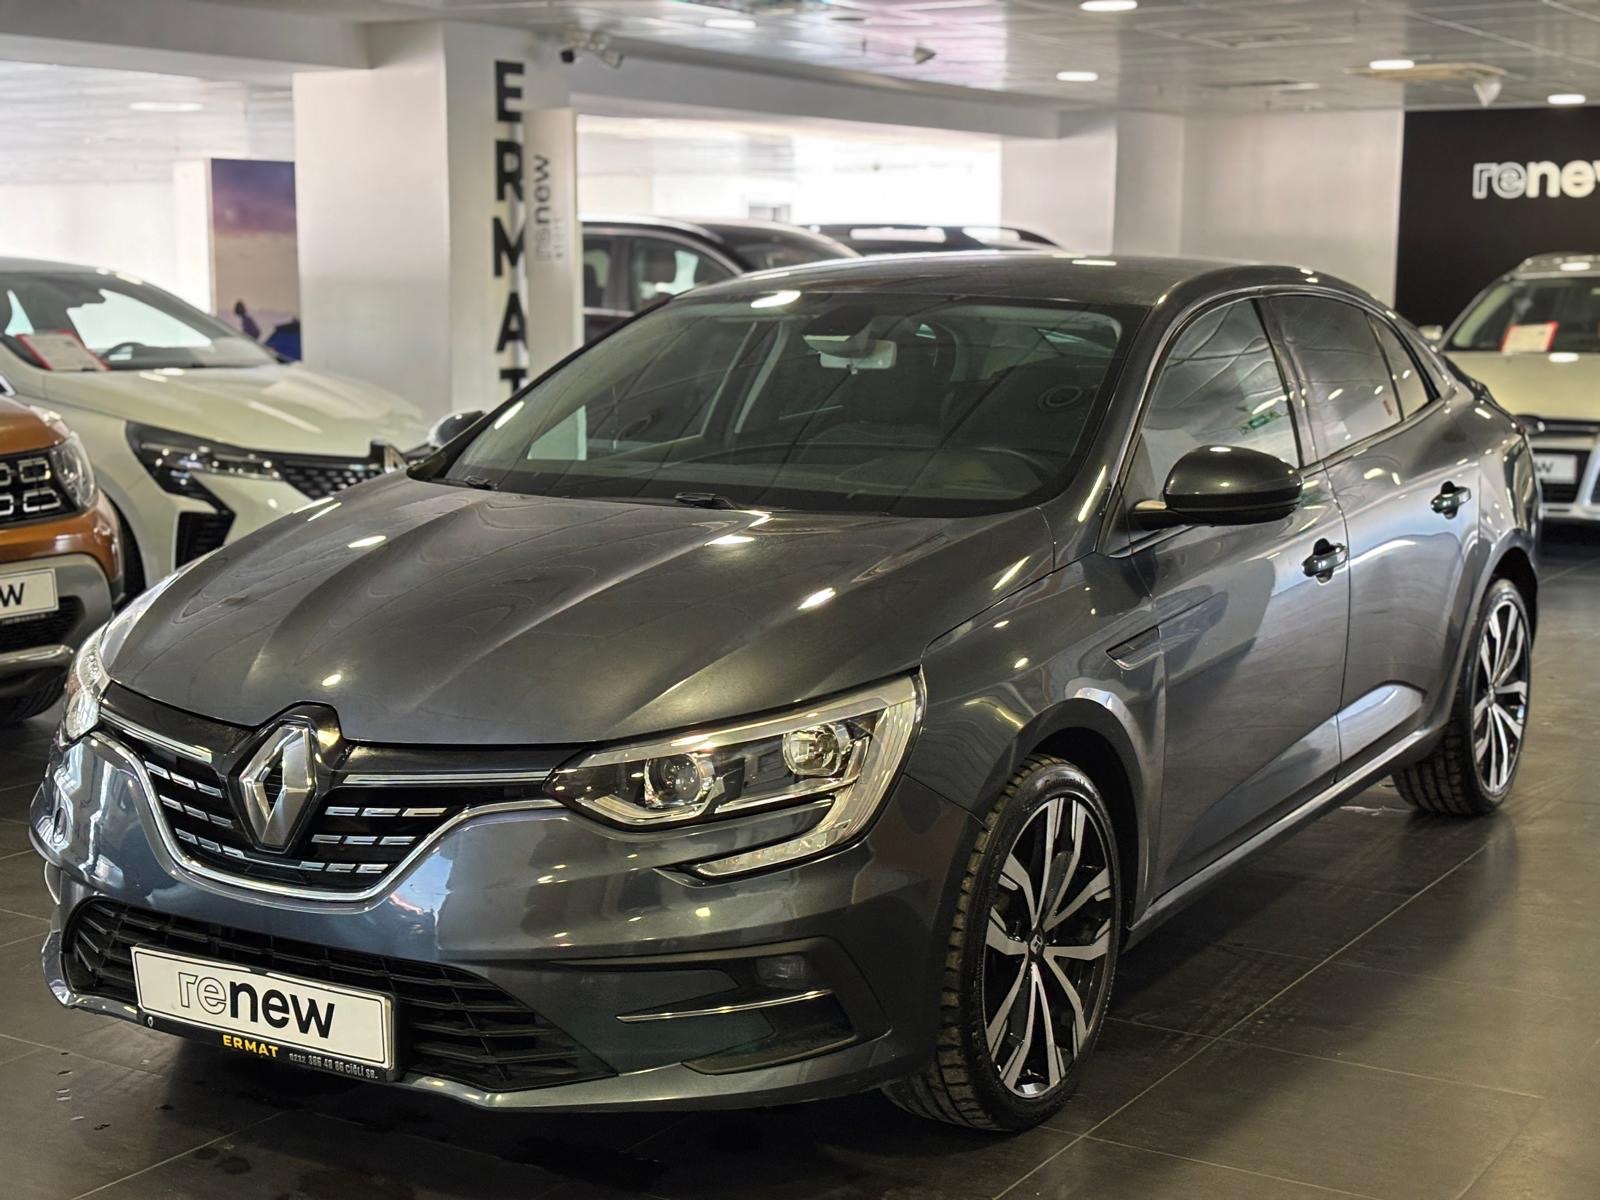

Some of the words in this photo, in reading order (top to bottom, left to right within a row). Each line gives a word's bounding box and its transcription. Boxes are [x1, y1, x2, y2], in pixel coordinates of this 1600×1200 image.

[1472, 160, 1600, 199] rene
[178, 971, 335, 1039] renew
[222, 1034, 279, 1058] ERMAT
